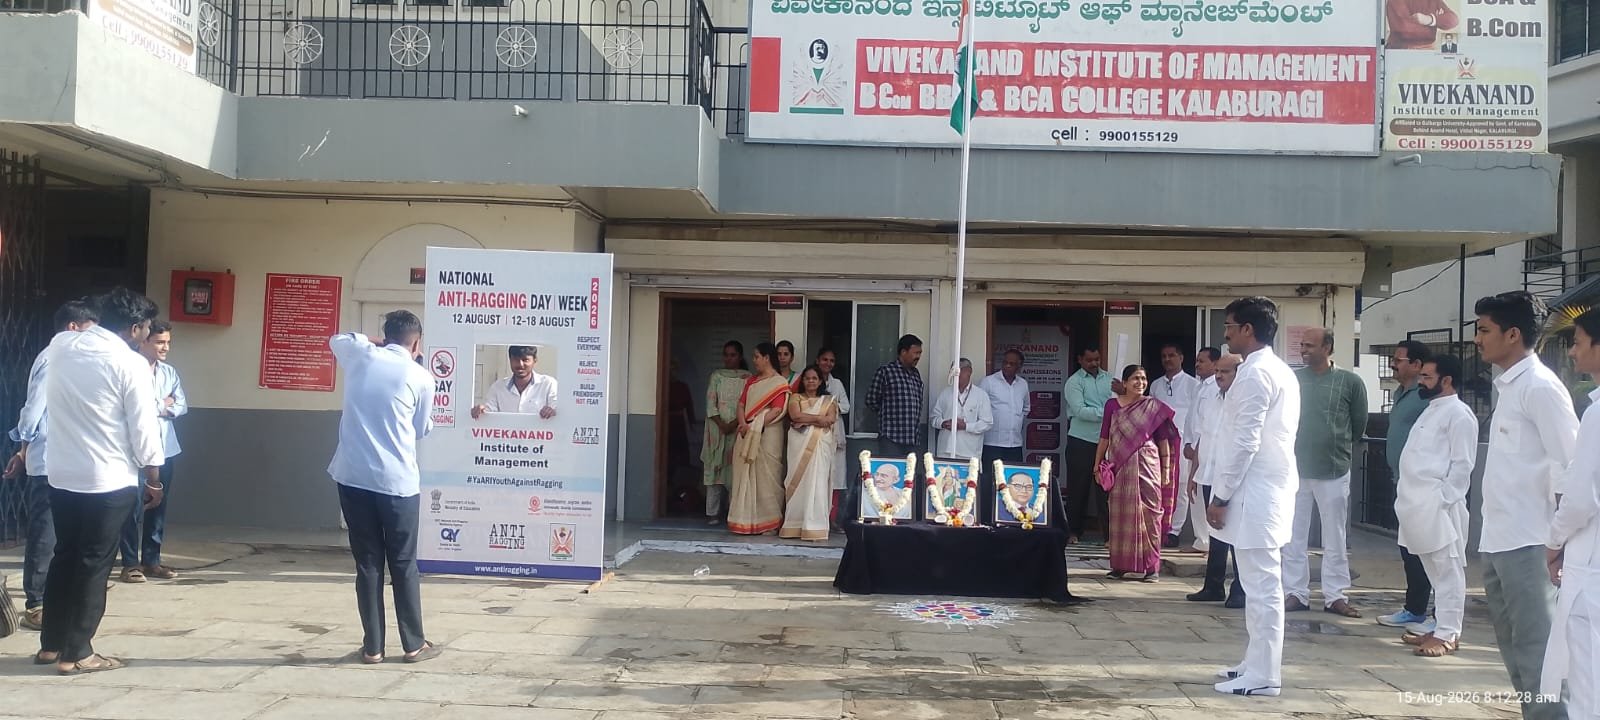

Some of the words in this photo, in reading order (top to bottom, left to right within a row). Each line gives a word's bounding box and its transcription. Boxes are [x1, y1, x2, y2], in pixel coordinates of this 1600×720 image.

[1467, 17, 1542, 37] B.Com
[866, 46, 1024, 76] VIVEKAAND
[1035, 50, 1162, 79] INSTITUTE
[1168, 53, 1198, 79] OF
[1203, 53, 1370, 82] MANAGEMENT
[1398, 83, 1535, 105] VIVEKANAND
[979, 89, 998, 111] &
[1004, 86, 1053, 113] BCA
[1061, 87, 1162, 114] COLLEGE
[1168, 89, 1323, 118] KALABURAGI
[1393, 106, 1445, 116] Institute
[1450, 106, 1461, 116] of
[1466, 107, 1540, 118] Management
[1051, 126, 1078, 141] cell
[1099, 131, 1178, 143] 9900155129
[1399, 138, 1426, 149] Cell
[1440, 139, 1533, 150] 9900155129
[439, 271, 495, 286] NATIONAL
[438, 291, 527, 309] ANTI-RAGGING
[530, 294, 552, 310] DAY
[558, 295, 588, 312] WEEK
[590, 281, 599, 327] 2026
[452, 313, 462, 324] 12
[464, 313, 501, 325] AUGUST
[539, 316, 576, 328] AUGUST
[576, 343, 601, 351] EVERYONE
[433, 394, 449, 406] NO
[472, 428, 554, 440] VIVEKANAND
[573, 427, 600, 437] ANTI
[480, 443, 527, 453] Institute
[533, 444, 543, 454] of
[474, 456, 548, 469] Management
[489, 524, 526, 538] ANTI
[489, 537, 525, 549] RAGGING
[475, 564, 538, 575] www.antiragging.in
